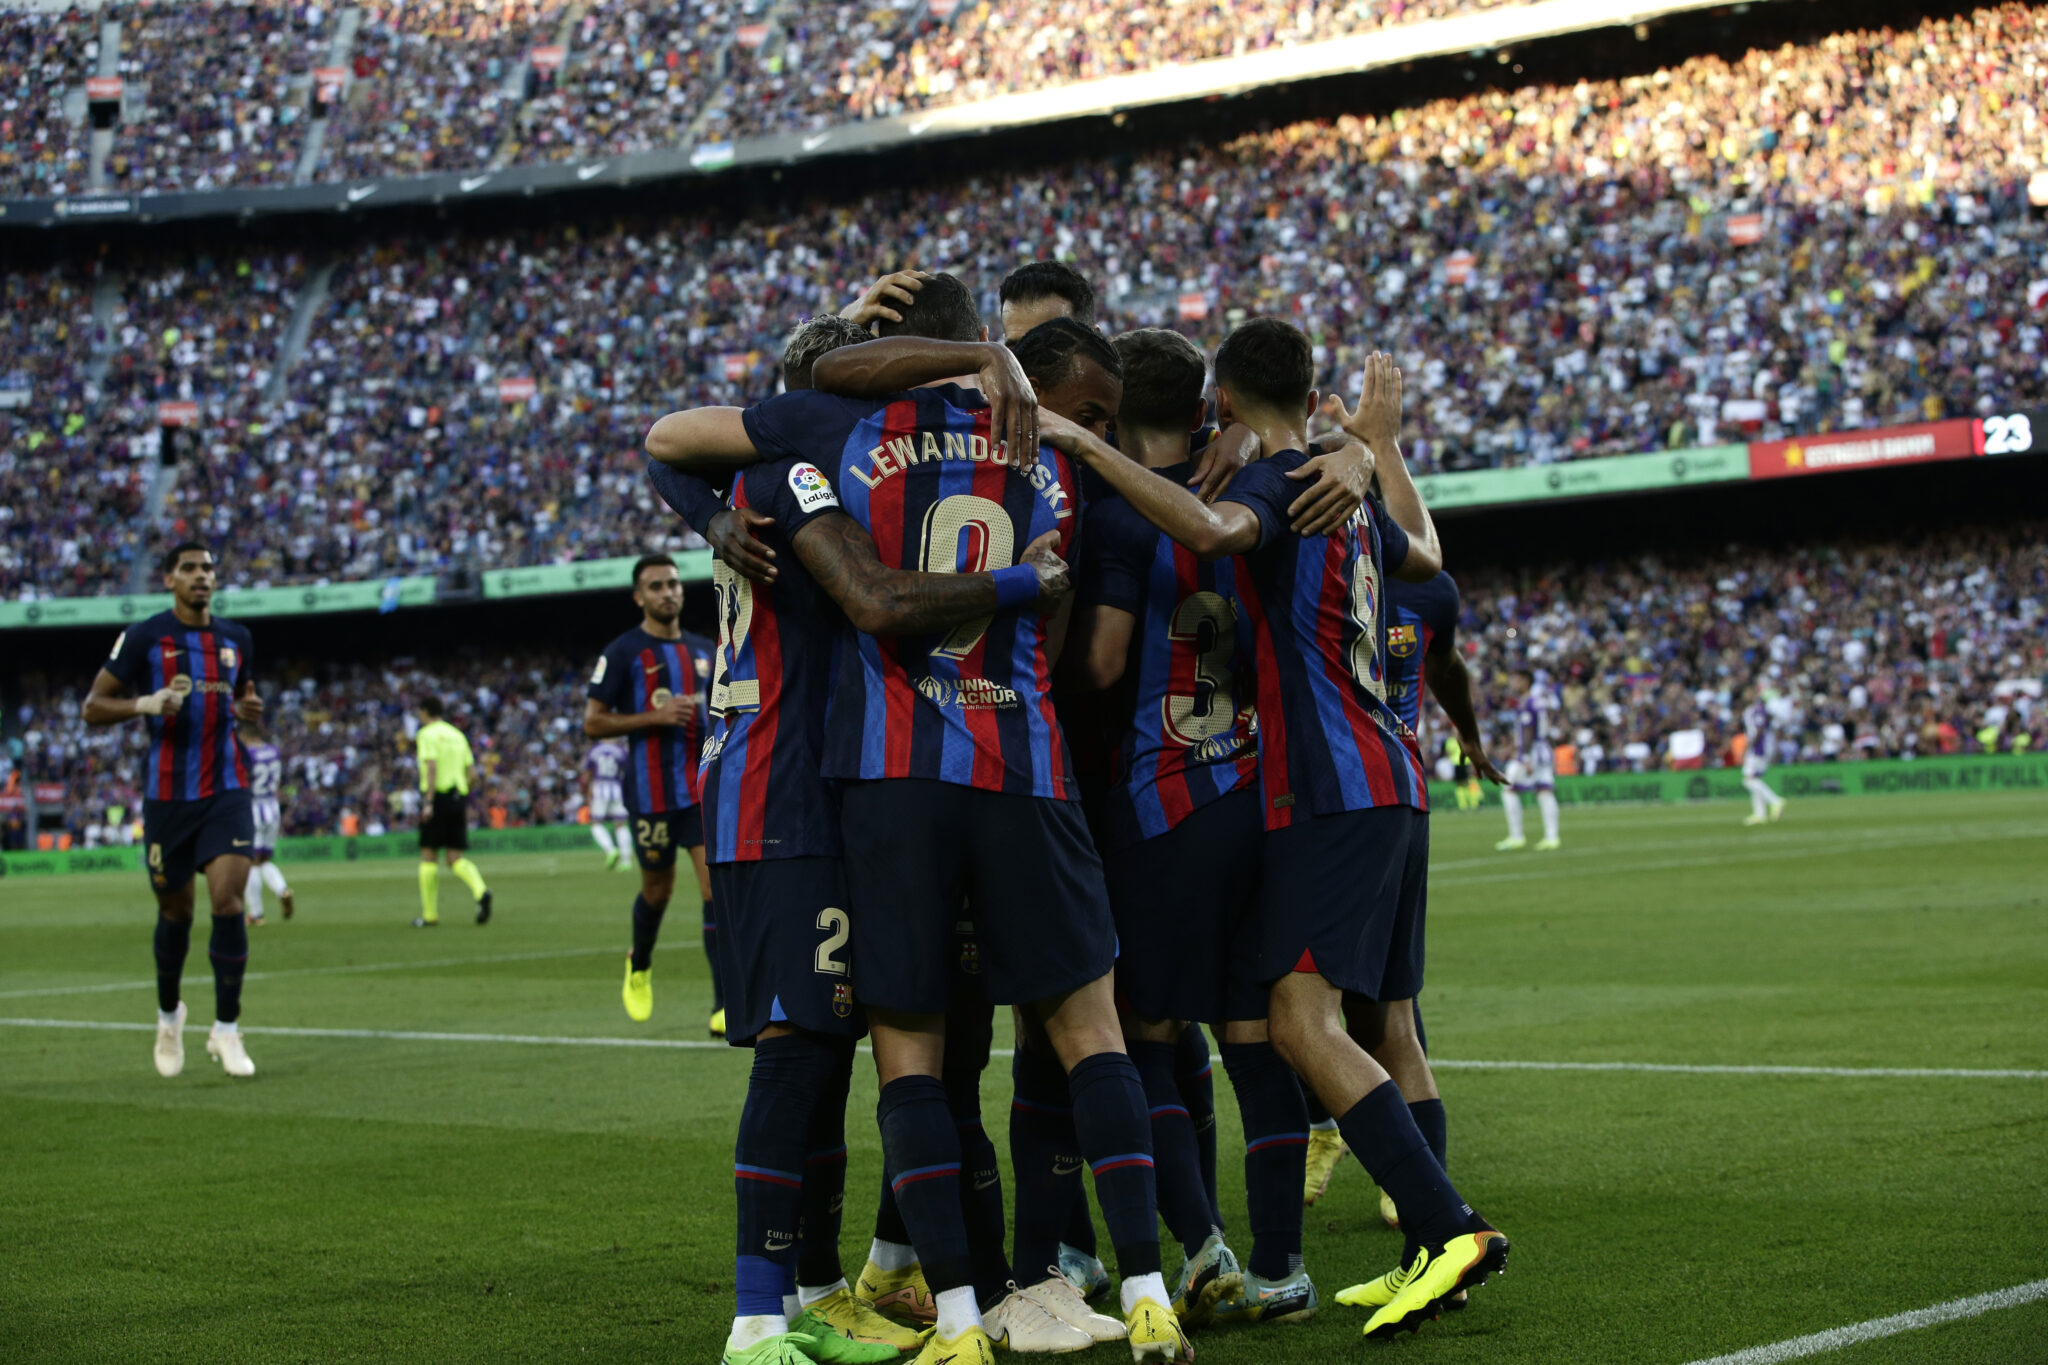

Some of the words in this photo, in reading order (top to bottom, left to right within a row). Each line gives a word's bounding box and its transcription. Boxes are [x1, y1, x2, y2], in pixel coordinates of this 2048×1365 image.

[1982, 413, 2033, 455] 23
[849, 432, 1073, 519] LEWANDOSKI
[955, 689, 1017, 704] ACNUR
[1162, 591, 1240, 747] 3
[637, 819, 670, 848] 24
[814, 907, 851, 978] 2
